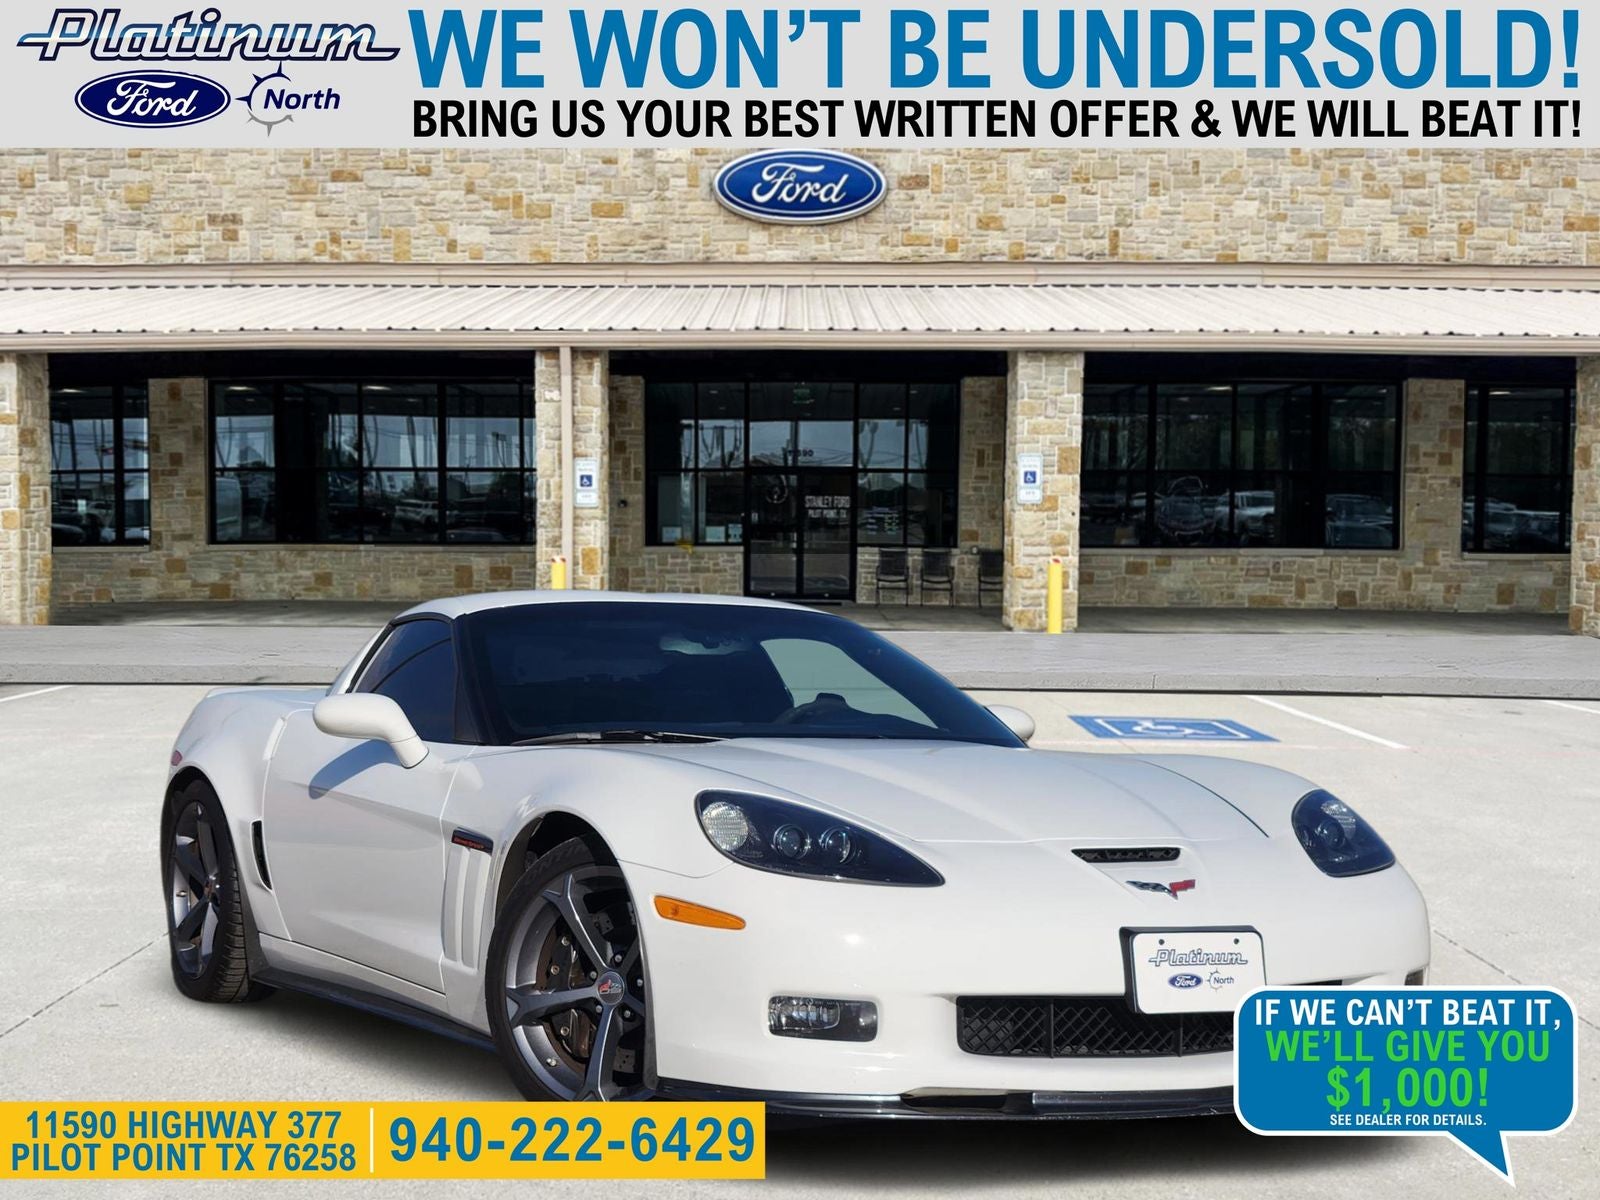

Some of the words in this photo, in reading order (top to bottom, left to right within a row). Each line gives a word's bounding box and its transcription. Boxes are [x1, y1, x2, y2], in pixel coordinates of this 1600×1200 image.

[751, 162, 849, 203] Ford
[1148, 947, 1248, 967] Platinum
[1174, 975, 1197, 988] Ford
[1213, 976, 1235, 985] North
